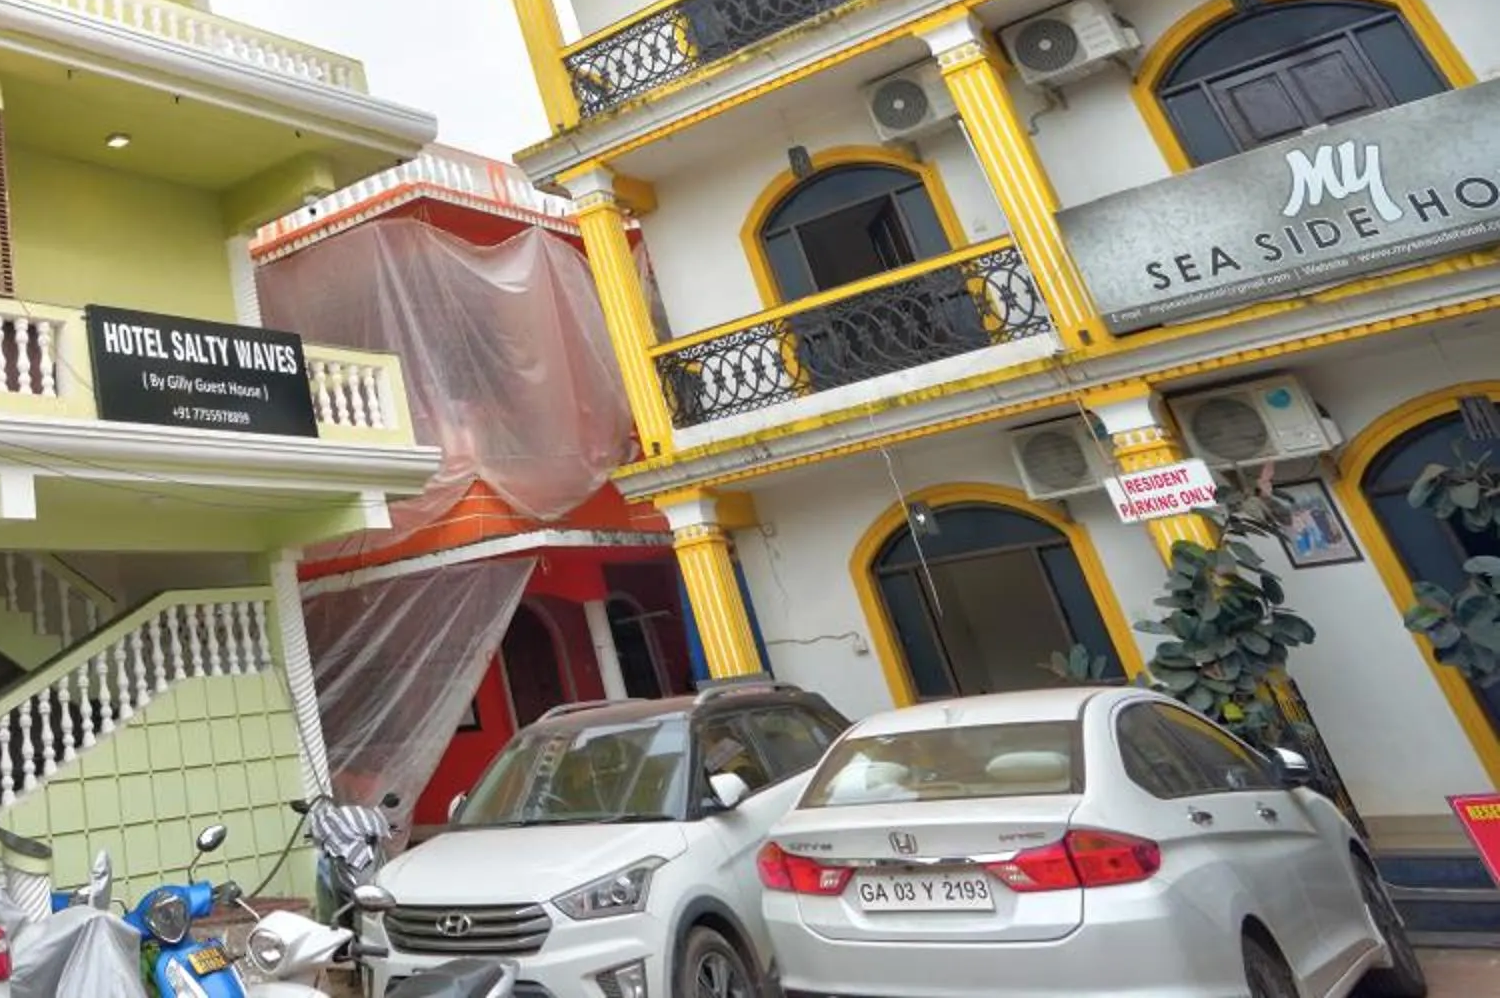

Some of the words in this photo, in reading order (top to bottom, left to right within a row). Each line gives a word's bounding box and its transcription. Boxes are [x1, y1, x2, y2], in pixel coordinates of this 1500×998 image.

[1146, 246, 1241, 290] SEA
[1254, 207, 1380, 263] SIDE
[103, 321, 169, 360] HOTEL
[171, 330, 229, 367] SALTY
[233, 339, 298, 375] WAVES
[167, 374, 192, 394] Gilly
[195, 377, 228, 395] Guest
[1124, 468, 1189, 495] RESIDENT
[1120, 493, 1179, 517] PARKING
[1180, 485, 1216, 506] ONLY
[860, 883, 889, 902] GA
[894, 882, 916, 901] 03
[921, 882, 933, 900] Y
[941, 879, 988, 901] 2193
